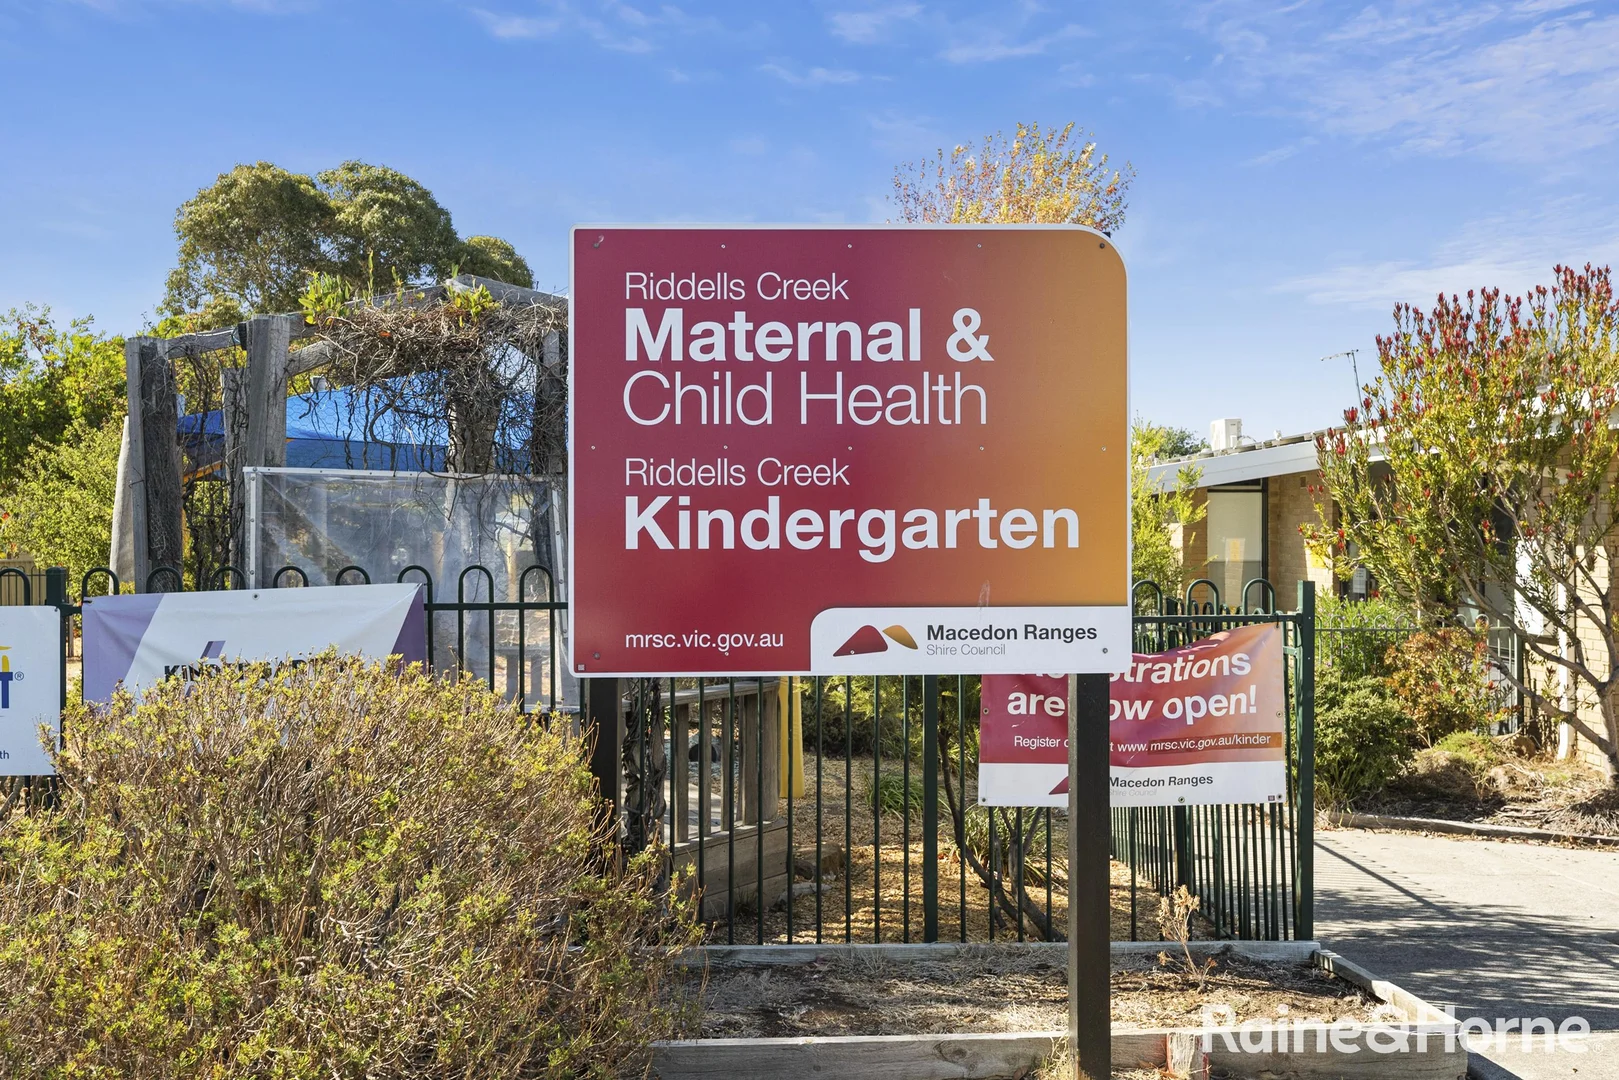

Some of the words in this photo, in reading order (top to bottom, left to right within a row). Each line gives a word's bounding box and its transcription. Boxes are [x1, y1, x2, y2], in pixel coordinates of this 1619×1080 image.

[625, 271, 746, 301] Riddells
[756, 271, 850, 301] Creek
[625, 307, 922, 362] Maternal
[946, 307, 995, 362] &
[623, 370, 773, 426] Child
[800, 371, 988, 426] Health
[625, 457, 746, 487] Riddells
[757, 457, 850, 486] Creek
[625, 495, 1080, 563] Kindergarten
[625, 630, 784, 653] mrsc.vic.gov.au
[926, 624, 1018, 641] Macedon
[1024, 624, 1098, 644] Ranges
[926, 643, 957, 656] Shire
[960, 643, 1006, 656] Council
[1007, 692, 1066, 717] are
[1162, 684, 1257, 725] open!
[1014, 735, 1061, 750] Register
[1110, 777, 1165, 788] Macedon
[1168, 775, 1214, 787] Ranges
